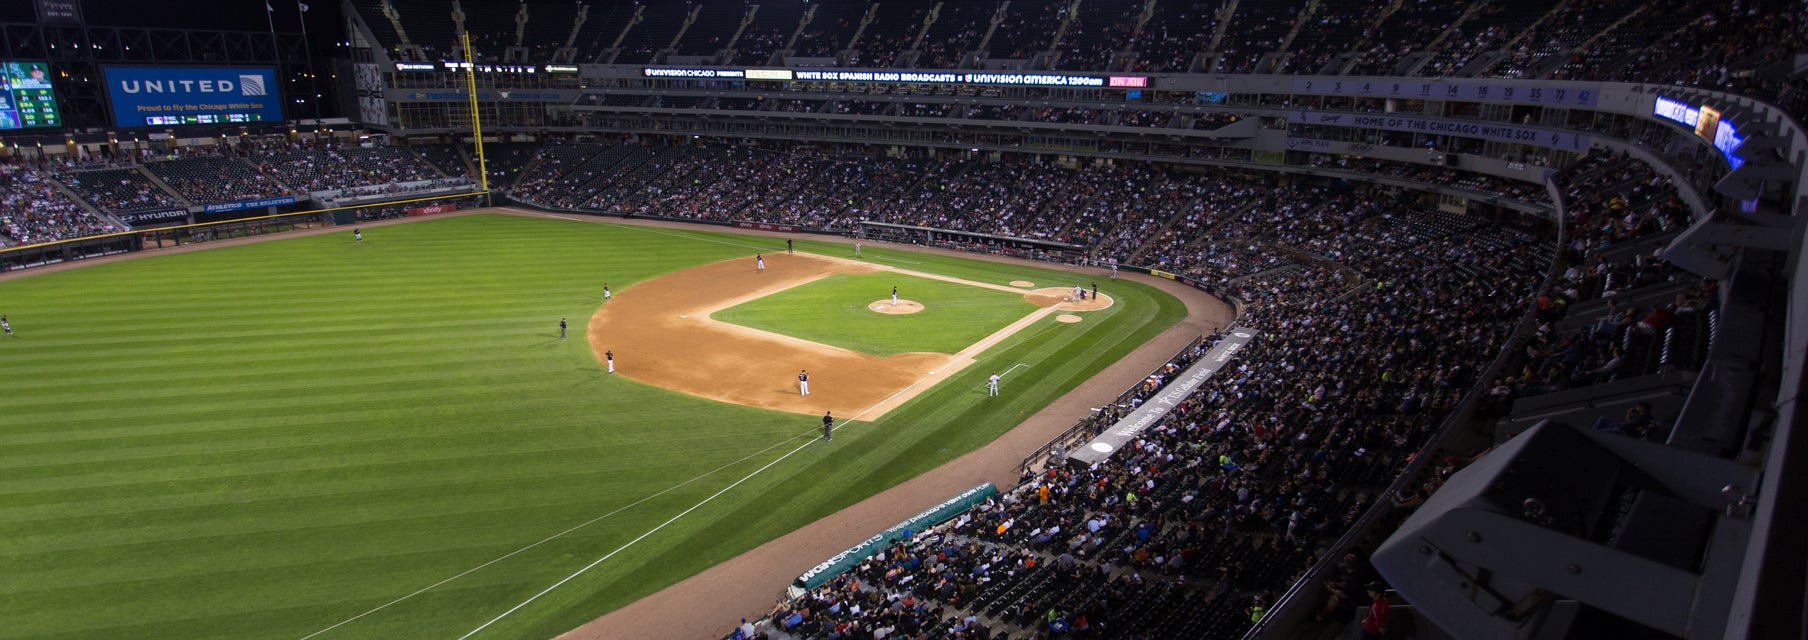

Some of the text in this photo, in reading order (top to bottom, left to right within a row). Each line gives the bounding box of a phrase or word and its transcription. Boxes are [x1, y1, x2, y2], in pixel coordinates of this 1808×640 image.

[796, 71, 821, 79] WHITE
[822, 72, 838, 80] SOX
[839, 72, 873, 80] SPANISH
[901, 73, 956, 82] BROADCASTS
[121, 80, 234, 93] UNITED
[1306, 81, 1312, 89] 2
[1335, 82, 1341, 90] 3
[1392, 83, 1399, 92] 9
[1422, 84, 1430, 93] 11
[1448, 85, 1458, 94] 14
[1478, 86, 1488, 95] 16
[1504, 87, 1513, 97] 19
[1530, 88, 1541, 98] 35
[136, 104, 161, 112] Proud
[173, 103, 184, 112] fly
[185, 103, 198, 111] the
[199, 103, 227, 111] Chicago
[1354, 117, 1537, 141] HOME OF THE CHICAGO WHITE SOX
[207, 202, 242, 211] ATHLETICO
[423, 206, 442, 214] xfinity
[138, 210, 187, 220] HYUNDAI
[1118, 414, 1155, 436] Welcome
[909, 503, 945, 523] CHICAGO'S
[961, 489, 977, 499] OWN
